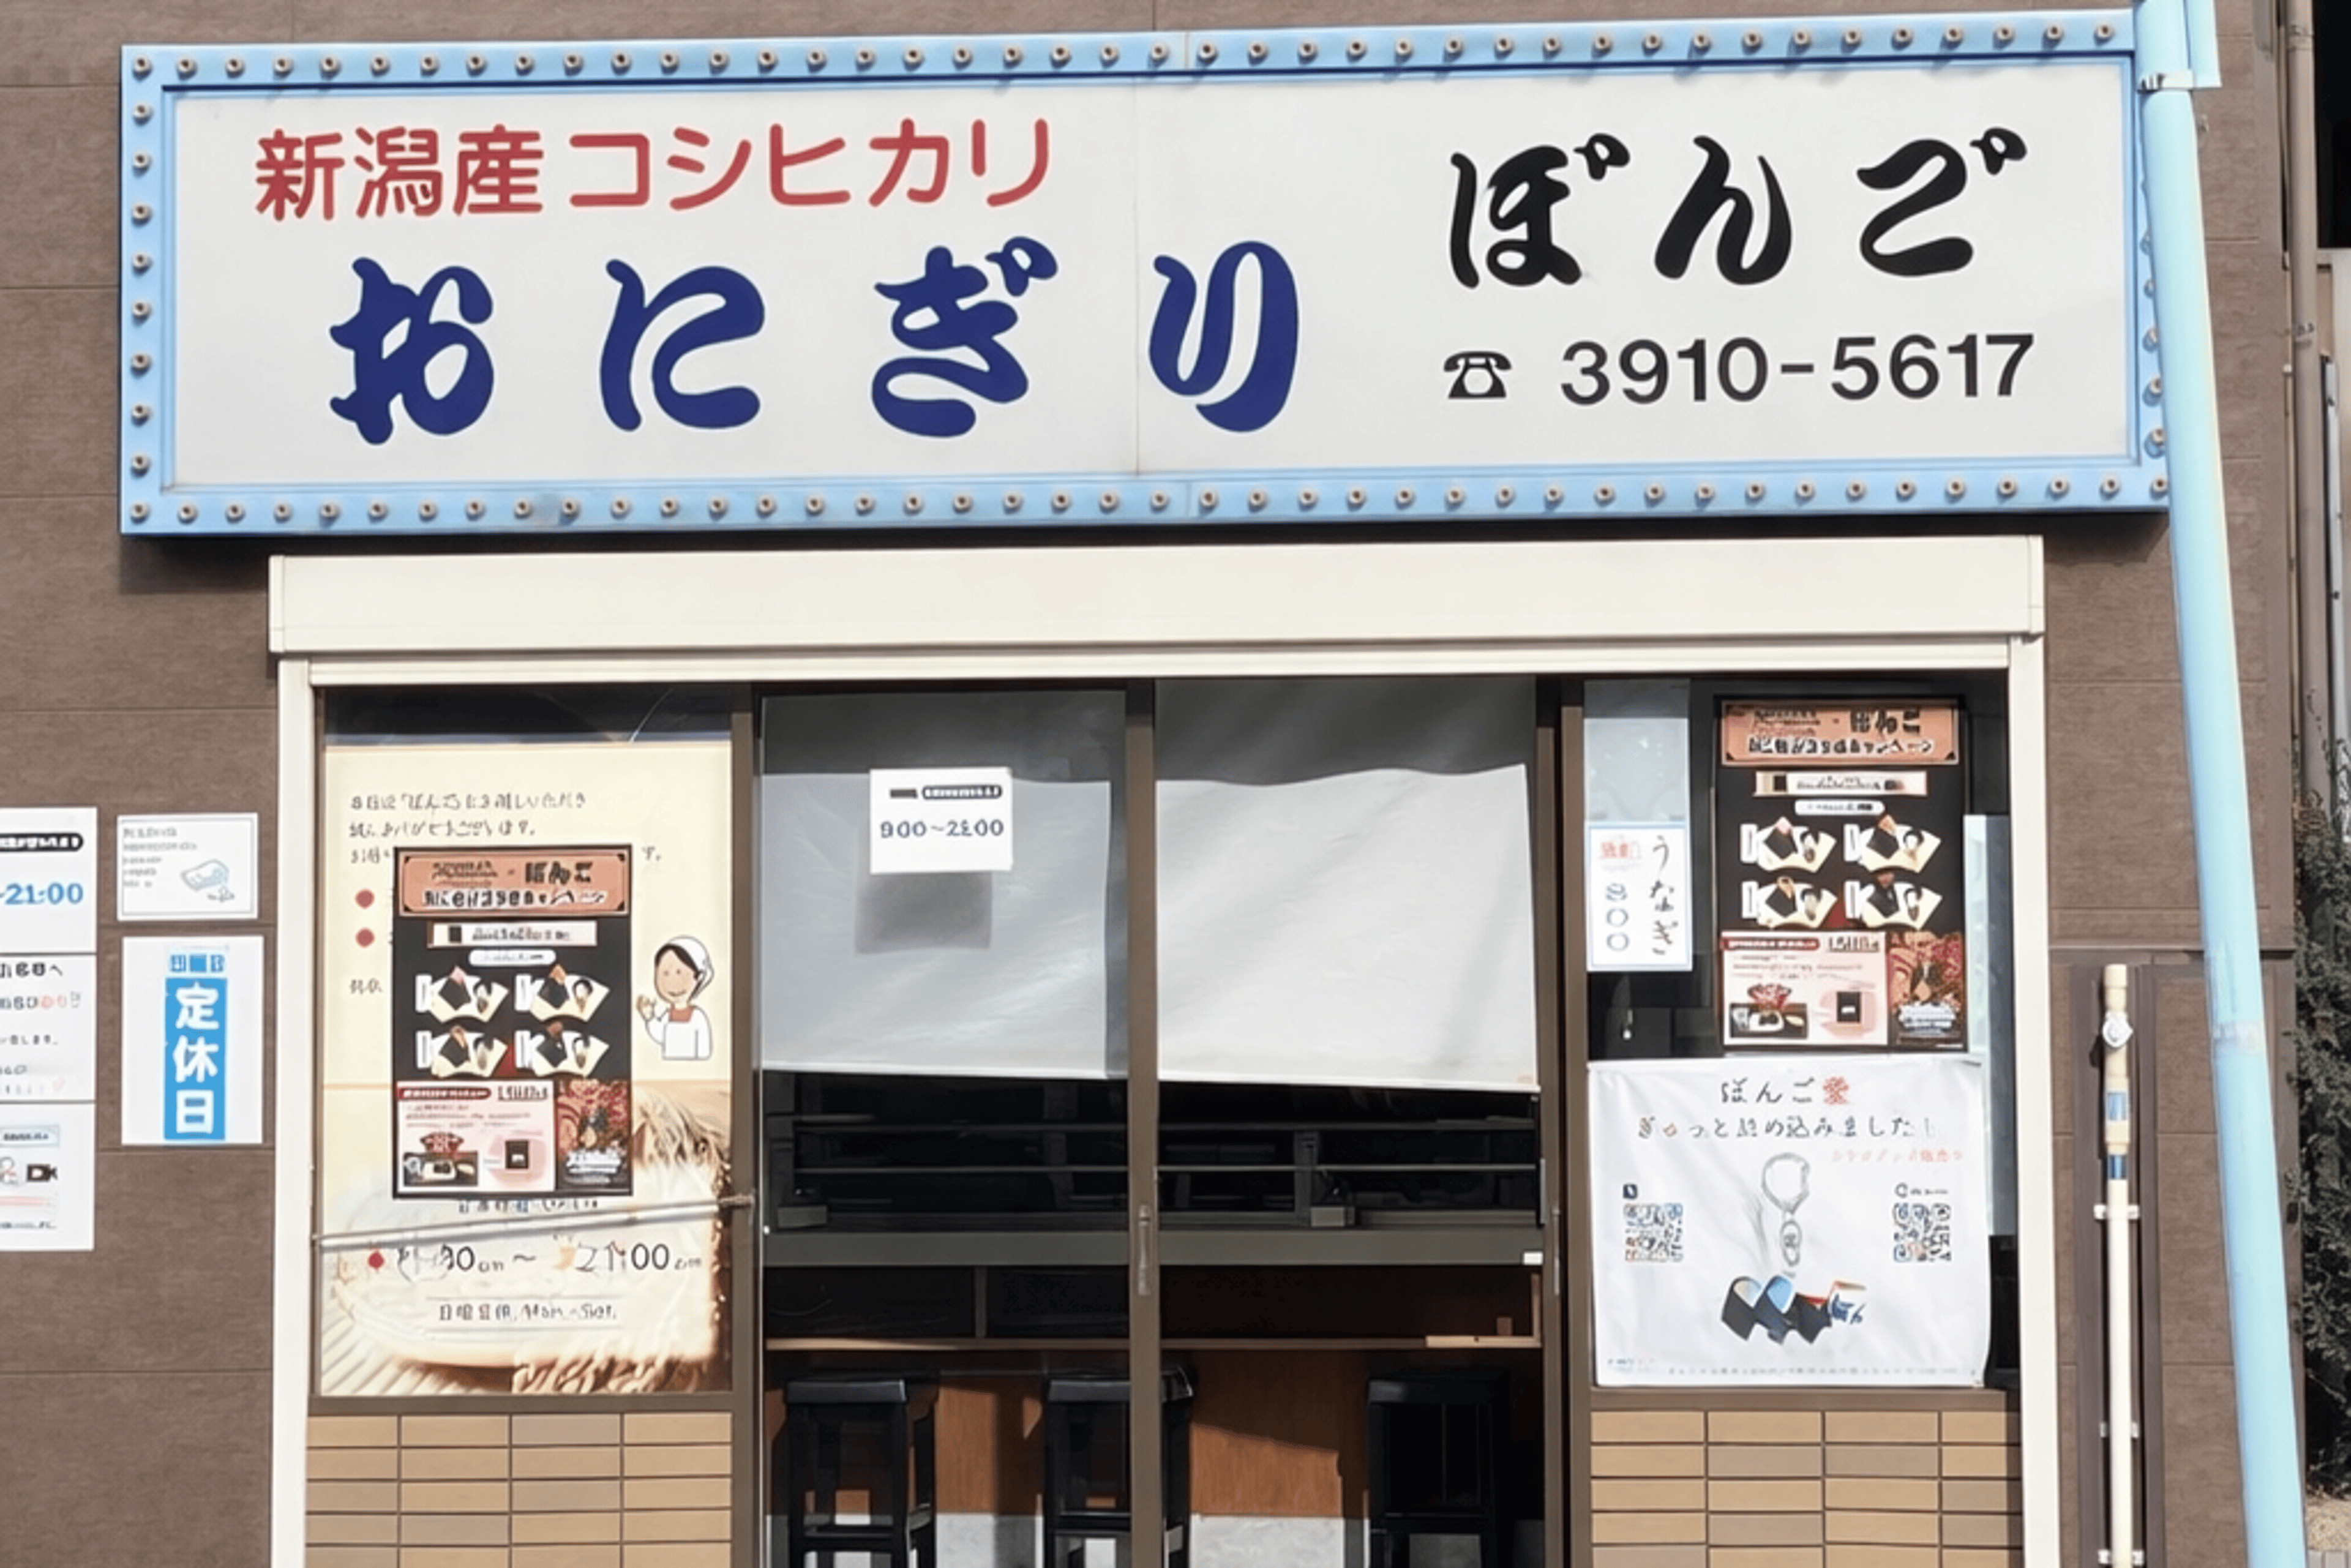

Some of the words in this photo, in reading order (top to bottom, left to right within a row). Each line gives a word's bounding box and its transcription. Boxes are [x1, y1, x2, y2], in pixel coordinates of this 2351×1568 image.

[255, 118, 1050, 222] 新潟産コシヒカリ
[1449, 127, 2028, 289] ぼんご
[329, 236, 1299, 445] おにぎり
[1561, 332, 2034, 407] 3910-5617
[172, 981, 220, 1135] 定休日
